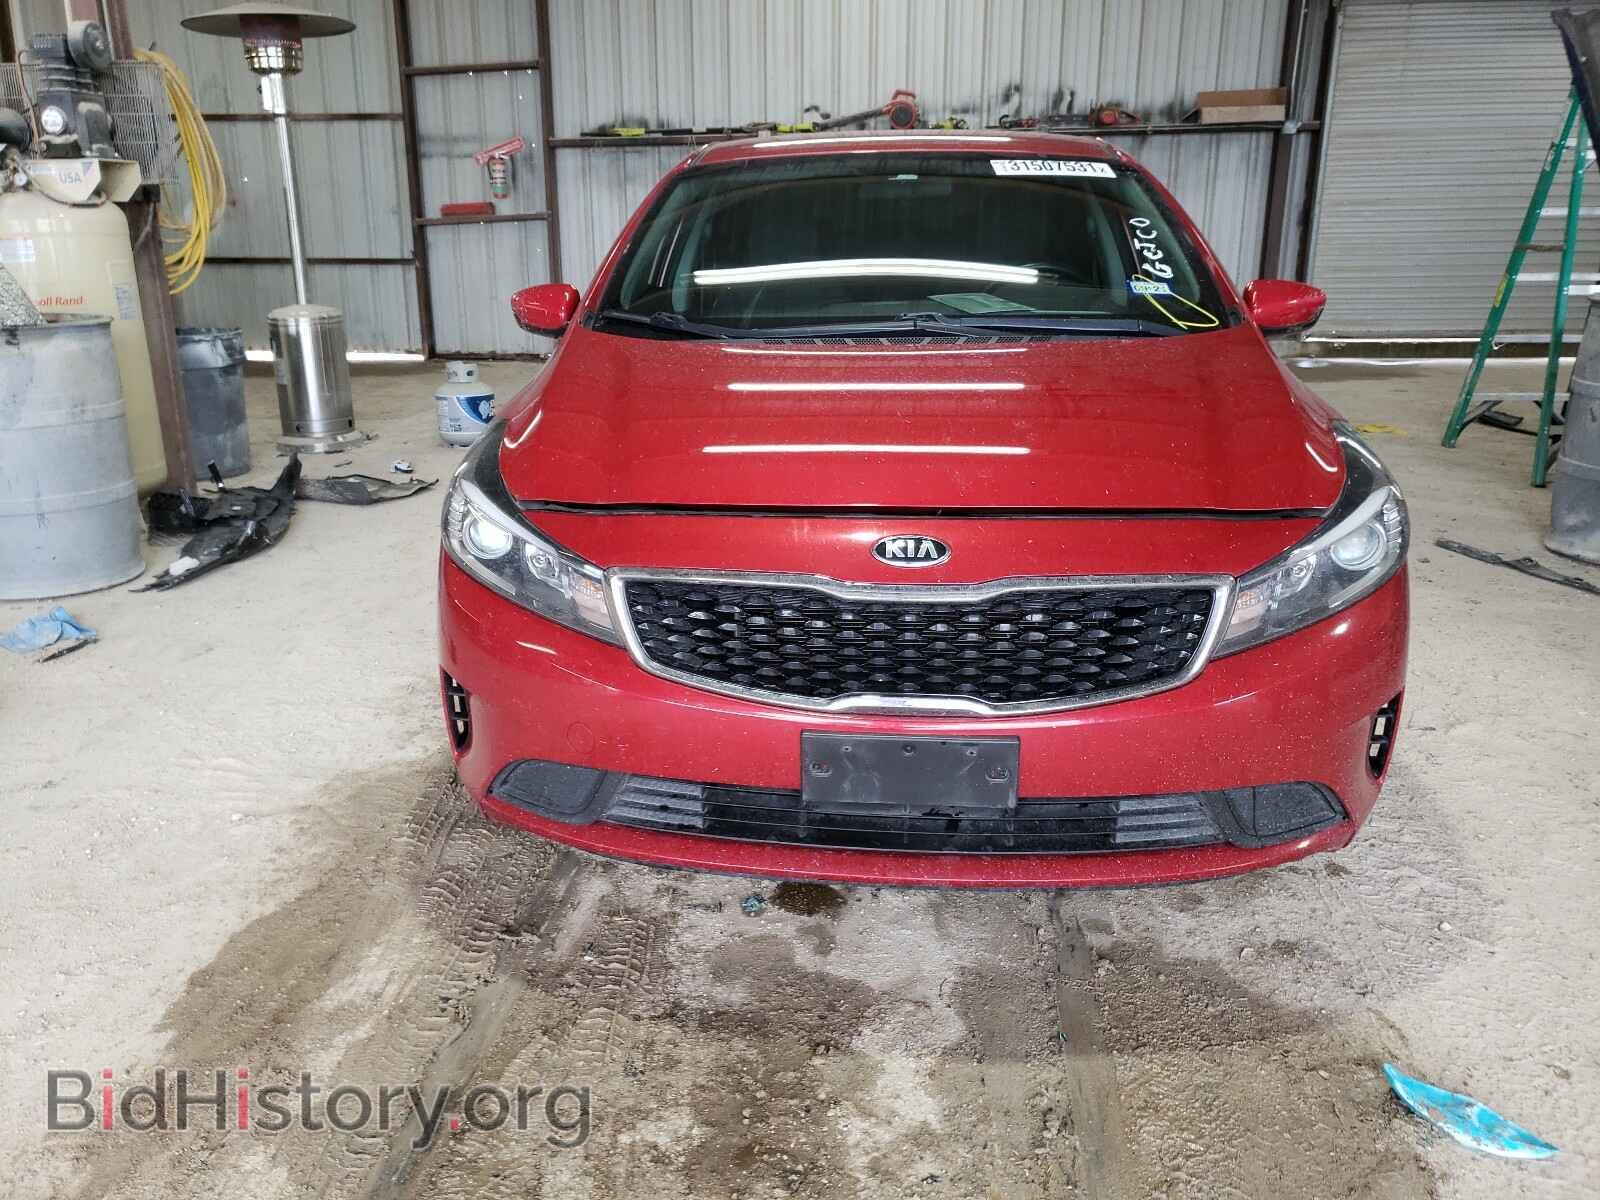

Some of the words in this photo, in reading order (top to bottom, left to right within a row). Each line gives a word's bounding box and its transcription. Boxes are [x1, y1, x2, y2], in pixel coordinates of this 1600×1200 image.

[59, 170, 82, 184] USA
[55, 295, 84, 305] Rand
[885, 539, 938, 558] KIA
